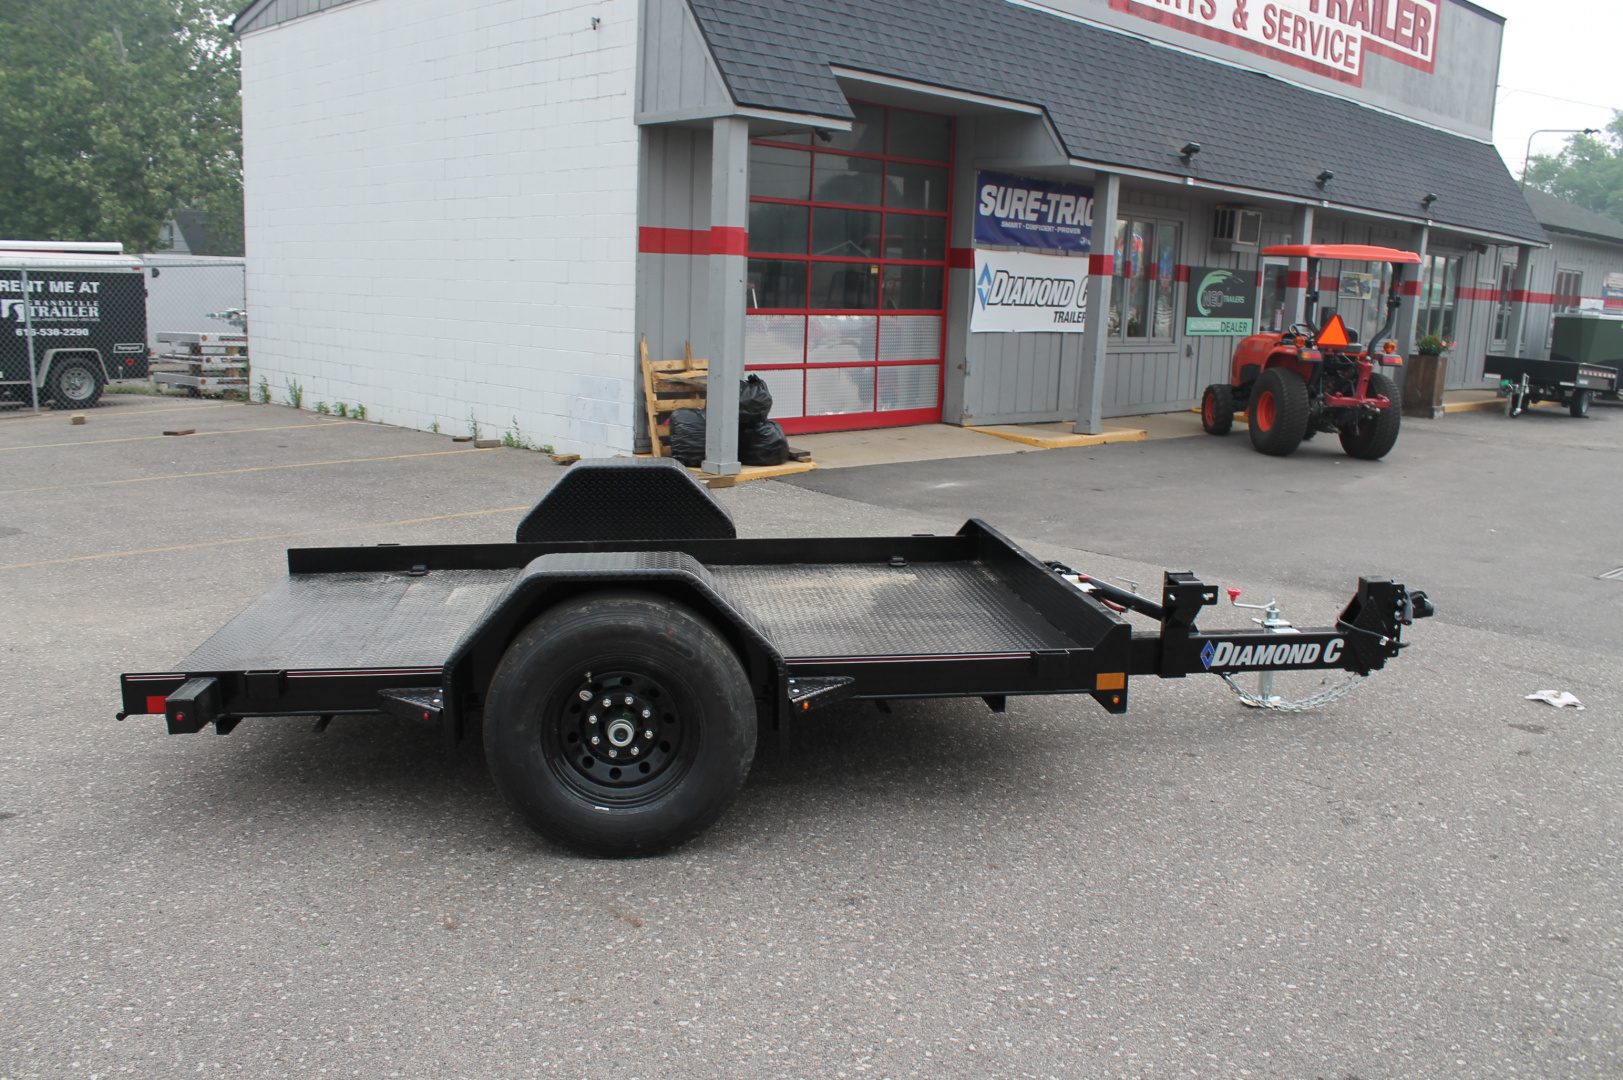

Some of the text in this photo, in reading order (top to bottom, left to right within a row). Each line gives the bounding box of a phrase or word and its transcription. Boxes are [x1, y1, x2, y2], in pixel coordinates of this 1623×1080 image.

[1309, 0, 1431, 56] AILER
[1262, 3, 1358, 70] SERVICE
[1001, 220, 1022, 229] SMART
[1057, 226, 1081, 234] PROVEN
[0, 280, 100, 293] RENT ME AT
[1203, 290, 1245, 308] NEO TRAILERS
[29, 306, 99, 318] TRAILER
[1220, 321, 1249, 333] DEALER
[1323, 638, 1345, 664] C
